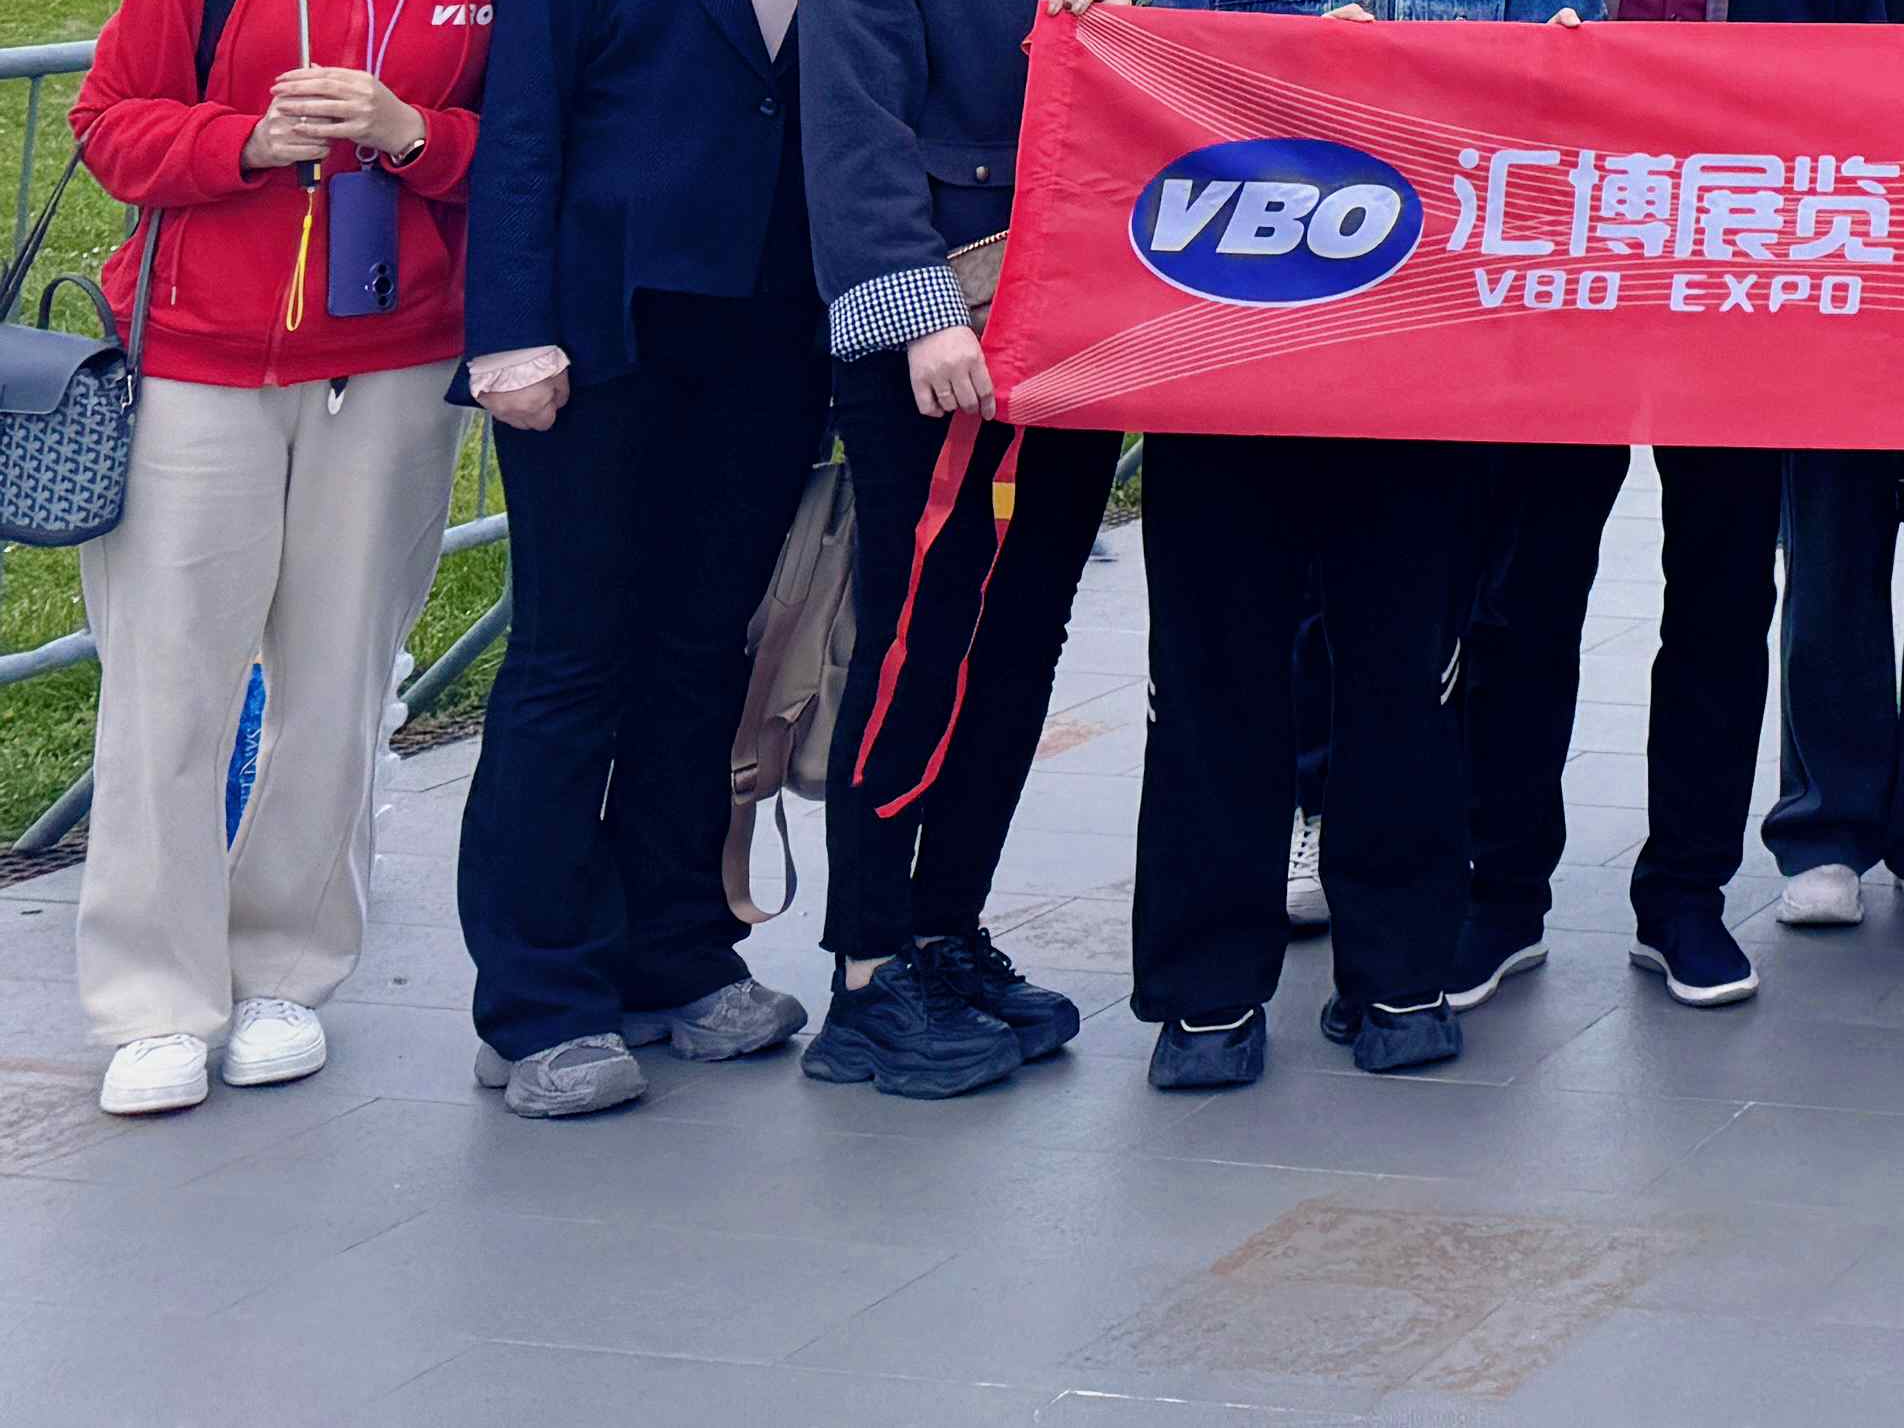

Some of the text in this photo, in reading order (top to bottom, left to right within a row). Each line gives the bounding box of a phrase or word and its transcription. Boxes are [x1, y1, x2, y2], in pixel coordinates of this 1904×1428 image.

[1149, 178, 1400, 260] VBO
[1448, 148, 1901, 263] 汇博展览
[1474, 268, 1863, 315] VBO EXPO
